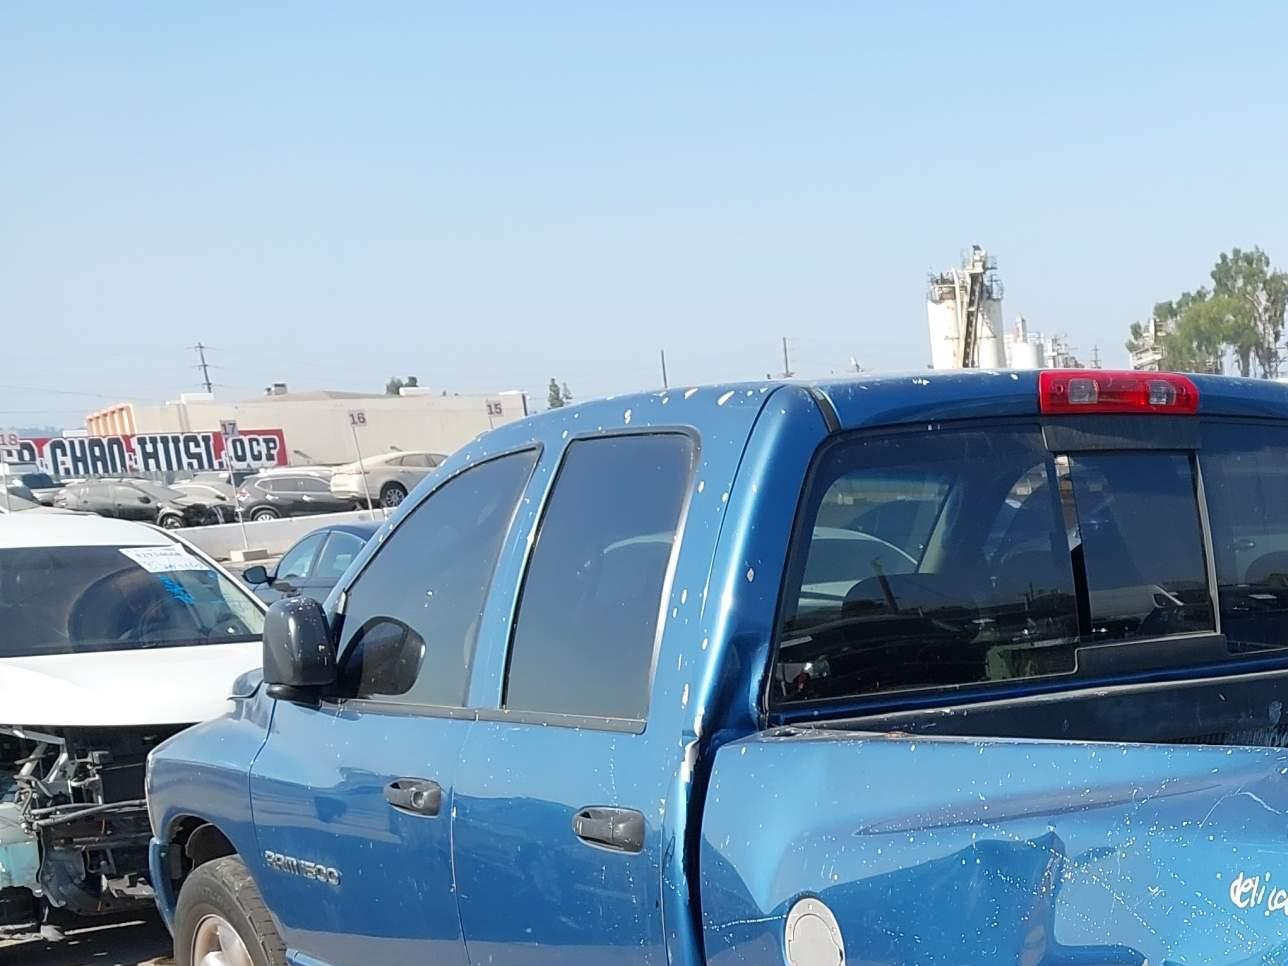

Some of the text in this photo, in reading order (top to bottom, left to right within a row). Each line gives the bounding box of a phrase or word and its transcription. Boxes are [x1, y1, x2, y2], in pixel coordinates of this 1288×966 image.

[487, 403, 503, 415] 15
[349, 412, 367, 425] 16
[221, 422, 237, 435] 17
[0, 433, 18, 446] 18
